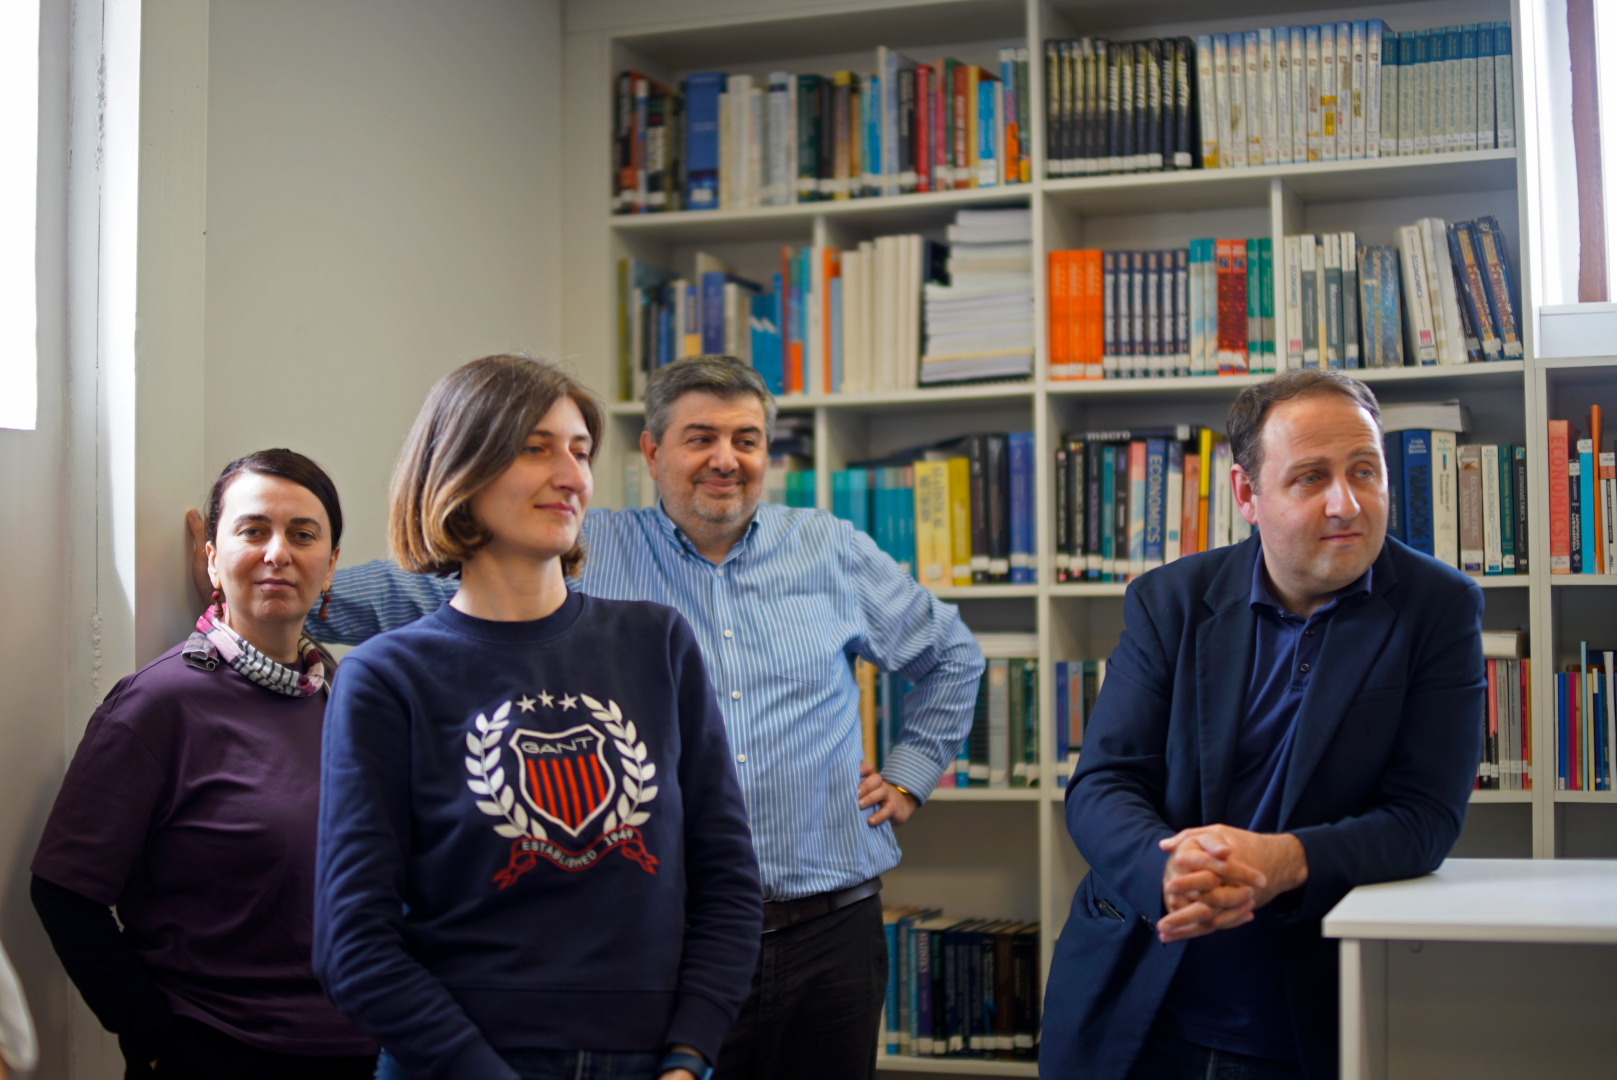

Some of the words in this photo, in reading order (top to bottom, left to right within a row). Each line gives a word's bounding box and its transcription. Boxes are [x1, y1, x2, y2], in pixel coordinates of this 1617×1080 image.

[1109, 66, 1118, 111] macro
[1123, 66, 1132, 110] macro
[1136, 64, 1145, 108] macro
[1148, 62, 1158, 107] macro
[1163, 60, 1172, 105] macro
[1178, 61, 1190, 106] macro
[1465, 263, 1489, 328] ECONOMICS
[1488, 262, 1512, 327] ECONOMICS
[1087, 430, 1130, 441] macro
[1147, 455, 1162, 543] ECONOMICS
[1462, 487, 1470, 530] ANALYSIS
[1470, 476, 1479, 540] ECONOMETRIC
[1551, 436, 1567, 537] ECONOMICS
[521, 735, 593, 754] GANT
[522, 841, 598, 867] ESTABLISHED
[603, 829, 633, 847] 1949
